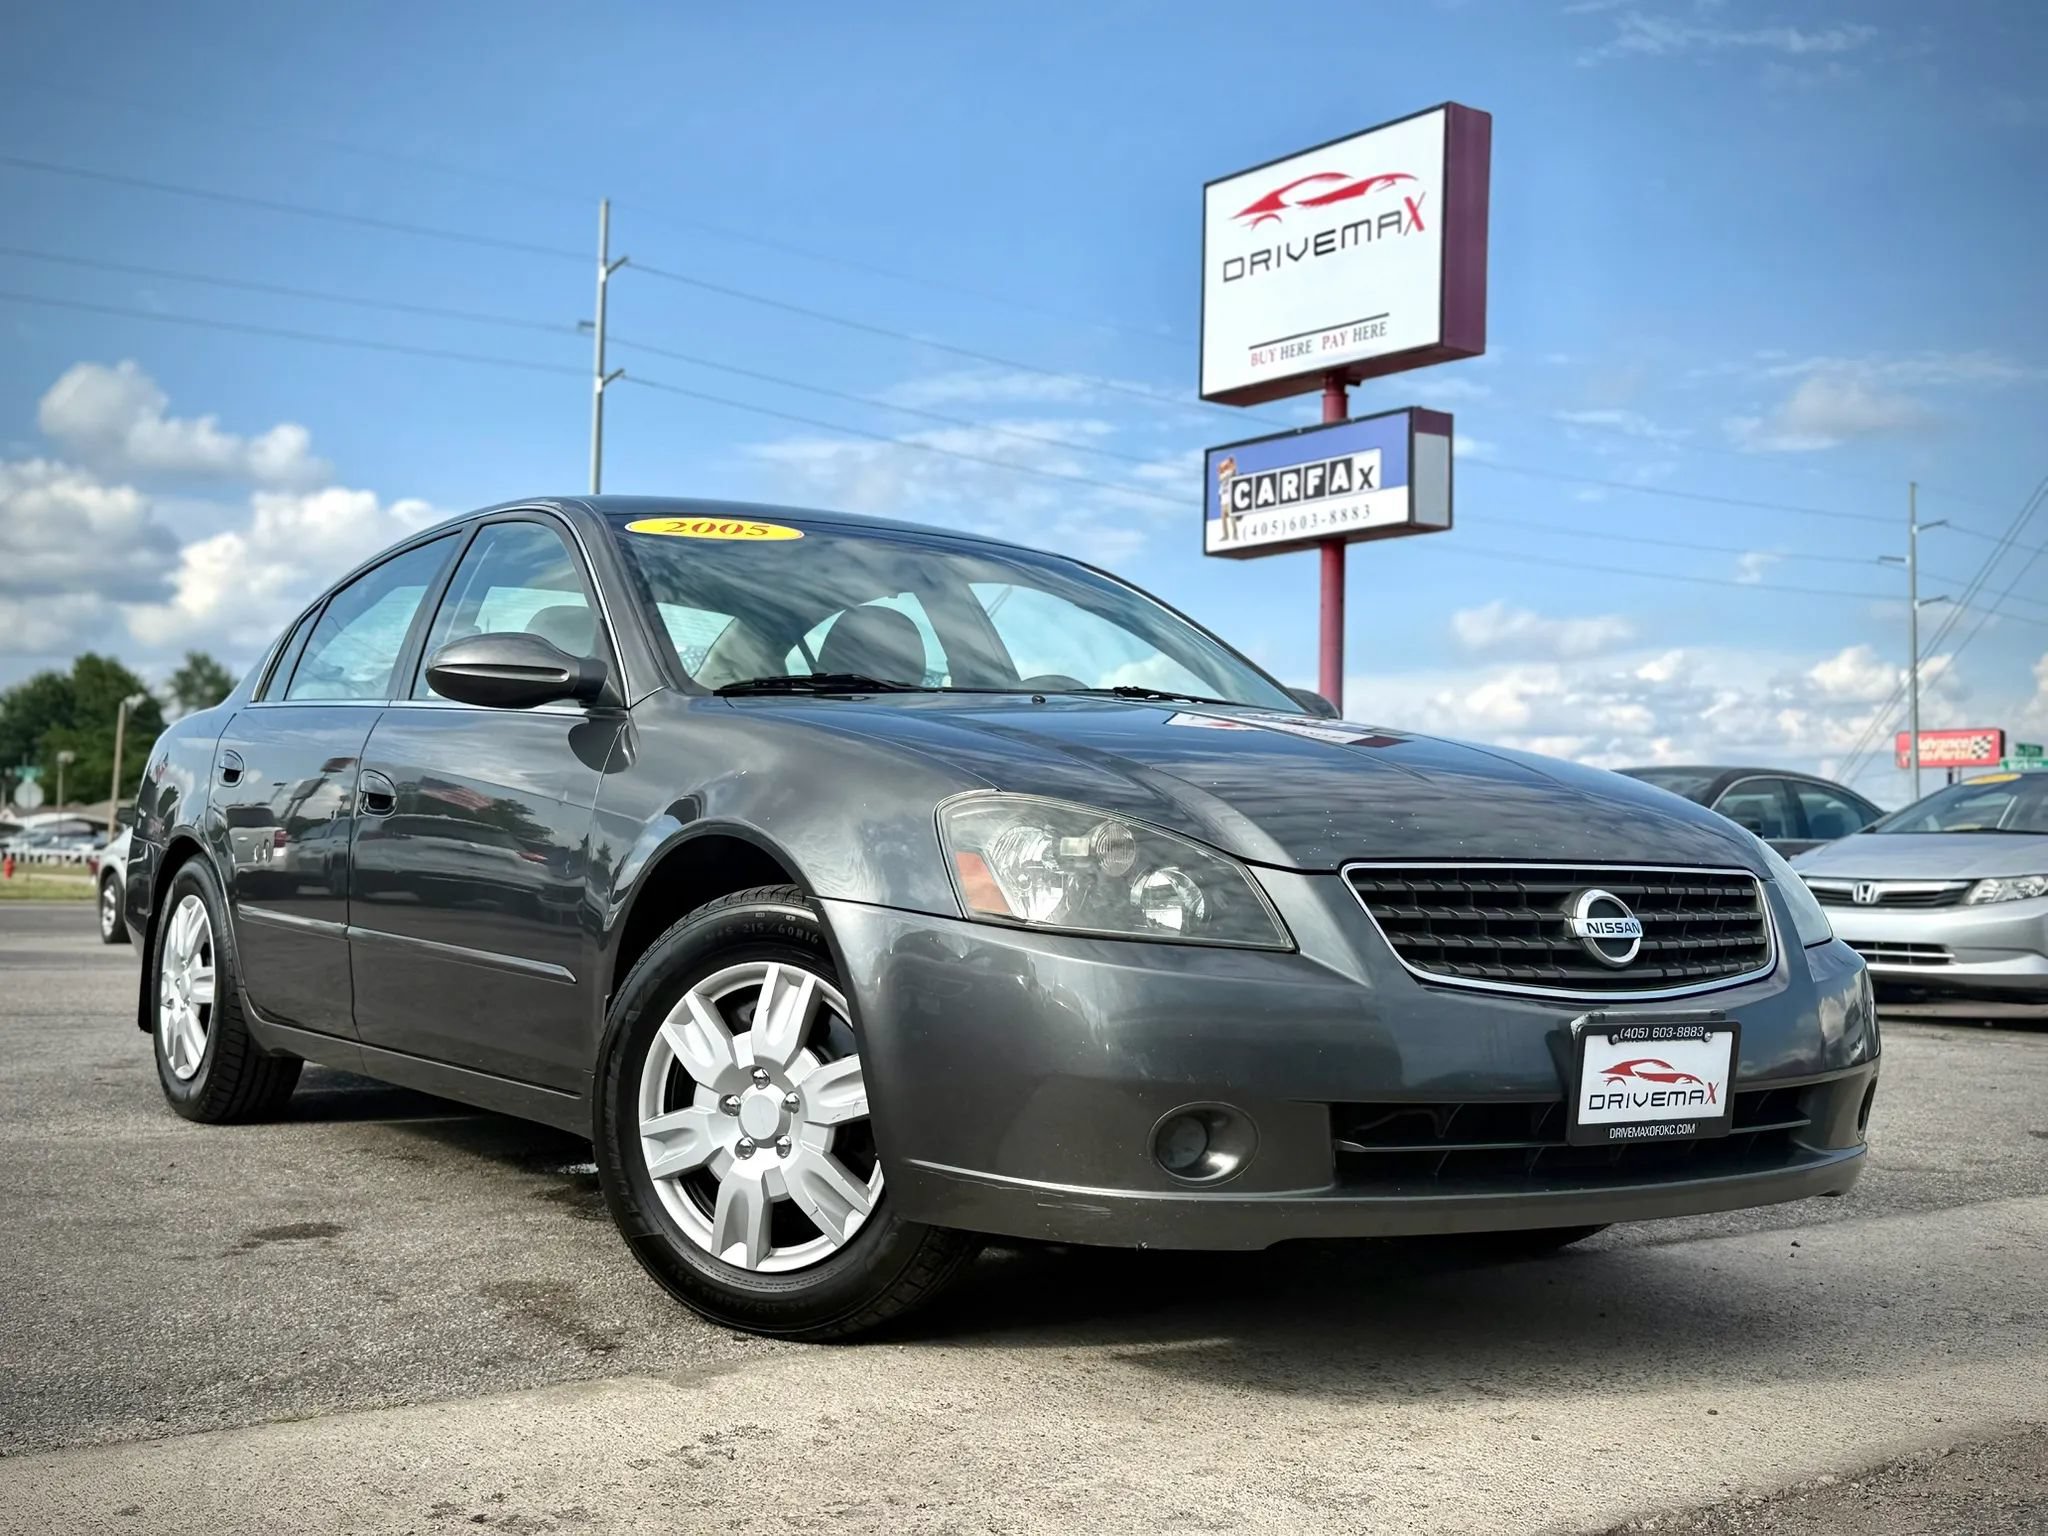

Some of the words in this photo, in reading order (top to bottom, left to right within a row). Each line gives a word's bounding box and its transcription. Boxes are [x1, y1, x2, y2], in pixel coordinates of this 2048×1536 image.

[1222, 191, 1426, 283] DRIVEMAX
[1250, 348, 1277, 366] BUY
[1280, 340, 1313, 360] HERE
[1322, 331, 1348, 350] PAY
[1352, 321, 1387, 342] HERE
[1233, 461, 1376, 510] CARFAX
[663, 521, 770, 536] 2005
[1242, 504, 1371, 541] (405)603-8883
[1586, 922, 1640, 934] NISSAN
[1620, 1027, 1649, 1039] (405)
[1652, 1026, 1704, 1038] 603-8883
[1588, 1082, 1719, 1110] DRIVEMAX
[1609, 1123, 1696, 1139] DRIVEMAXOFOKC.COM
